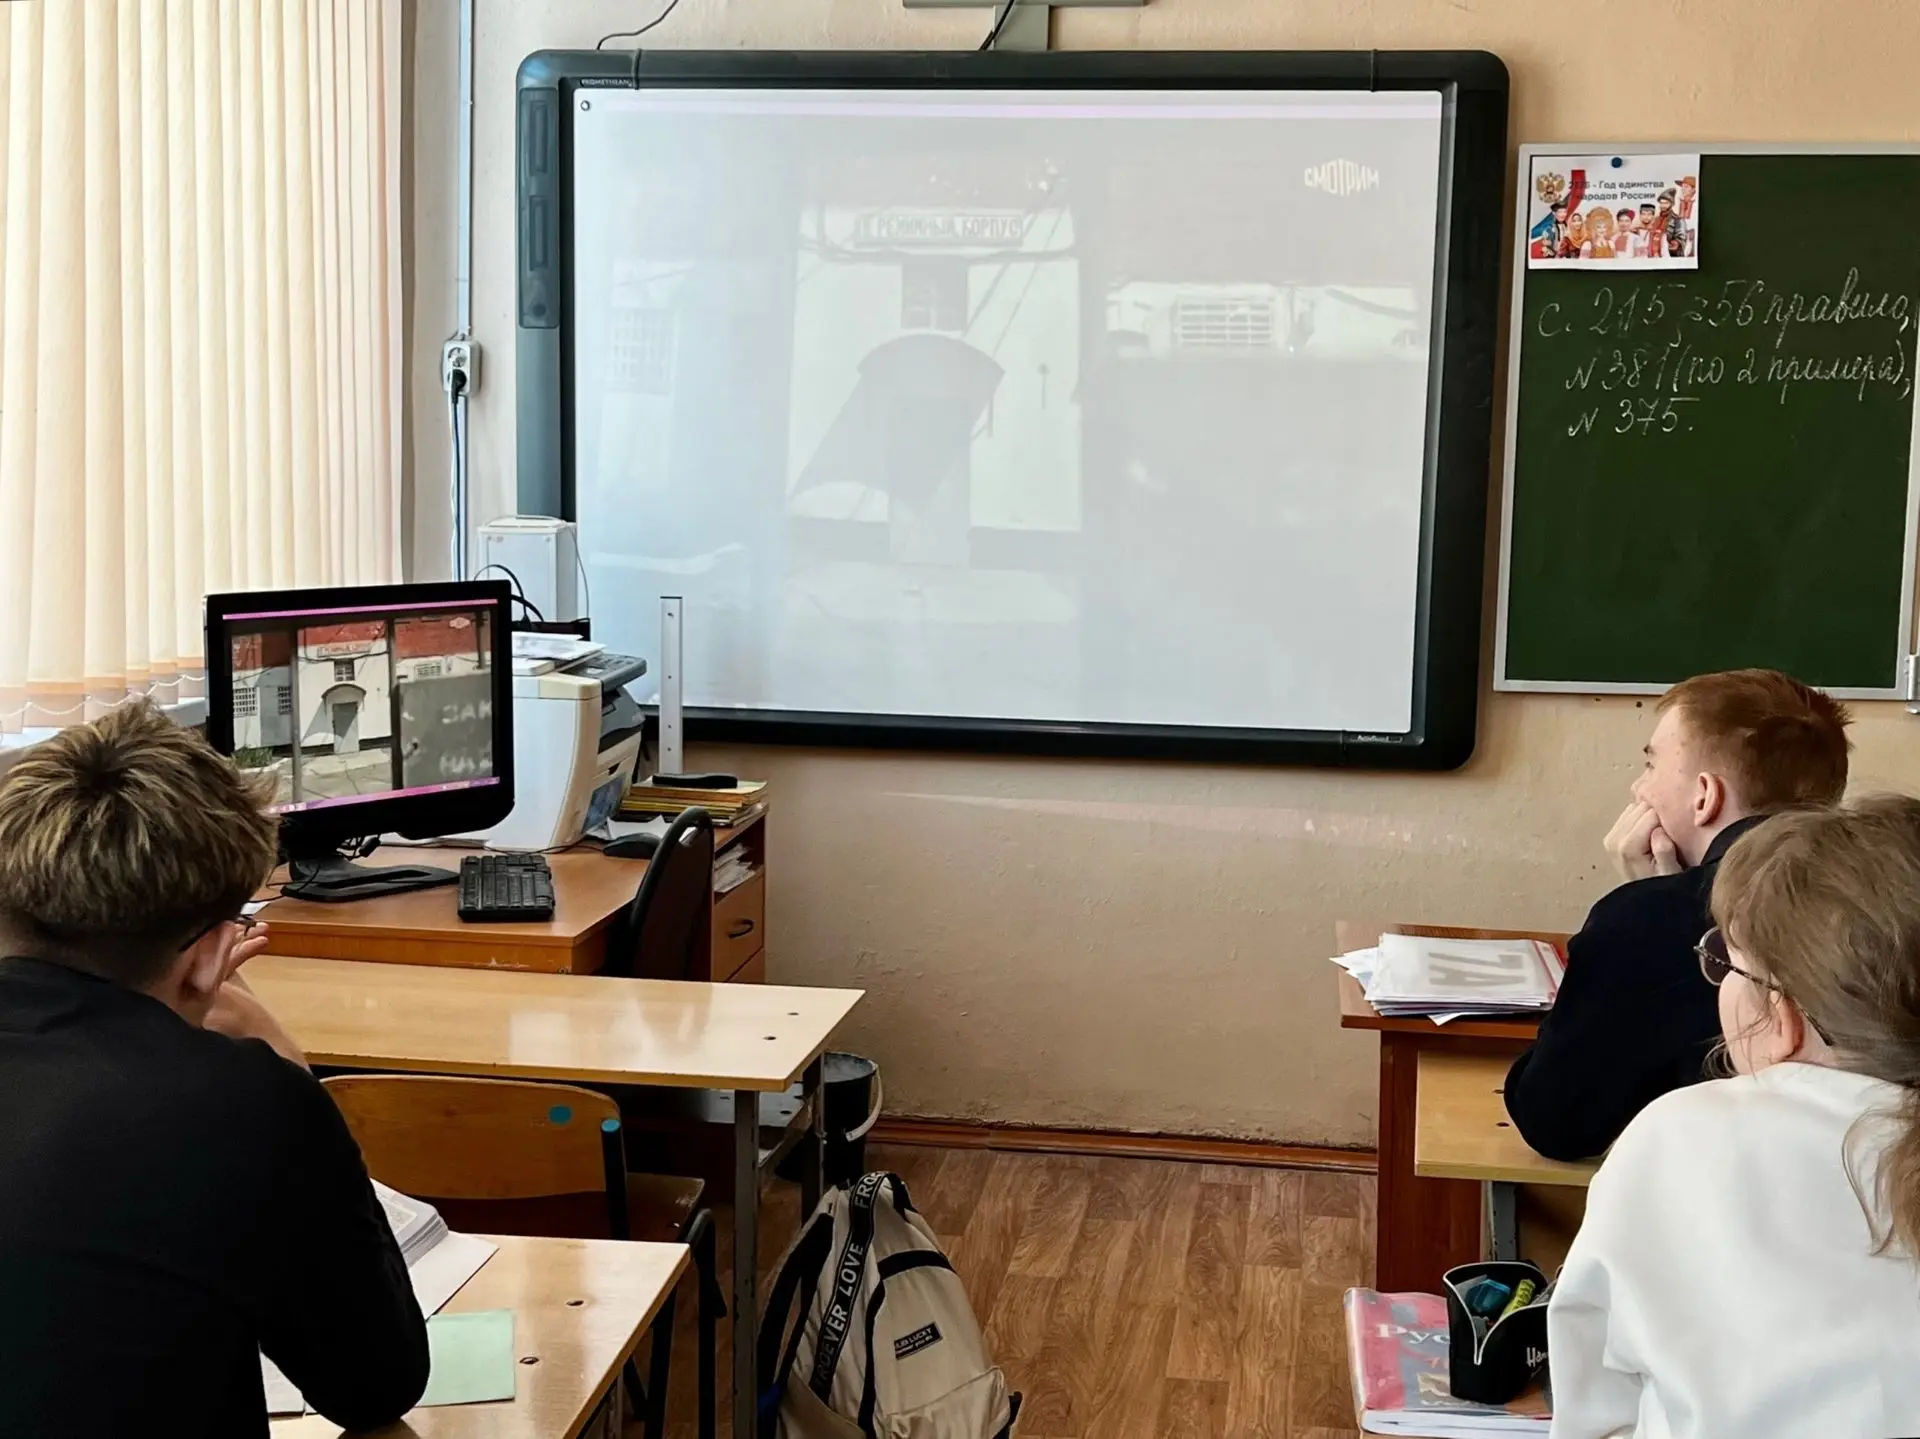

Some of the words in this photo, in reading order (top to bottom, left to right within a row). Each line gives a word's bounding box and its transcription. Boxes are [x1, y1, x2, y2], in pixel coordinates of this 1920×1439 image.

[1304, 158, 1379, 196] СМОТРИМ
[1599, 180, 1616, 190] Год
[1618, 181, 1665, 190] единства
[1620, 191, 1656, 200] России
[962, 214, 1019, 238] КОРПУС
[1737, 348, 1758, 385] 2
[839, 1242, 864, 1297] LOVE
